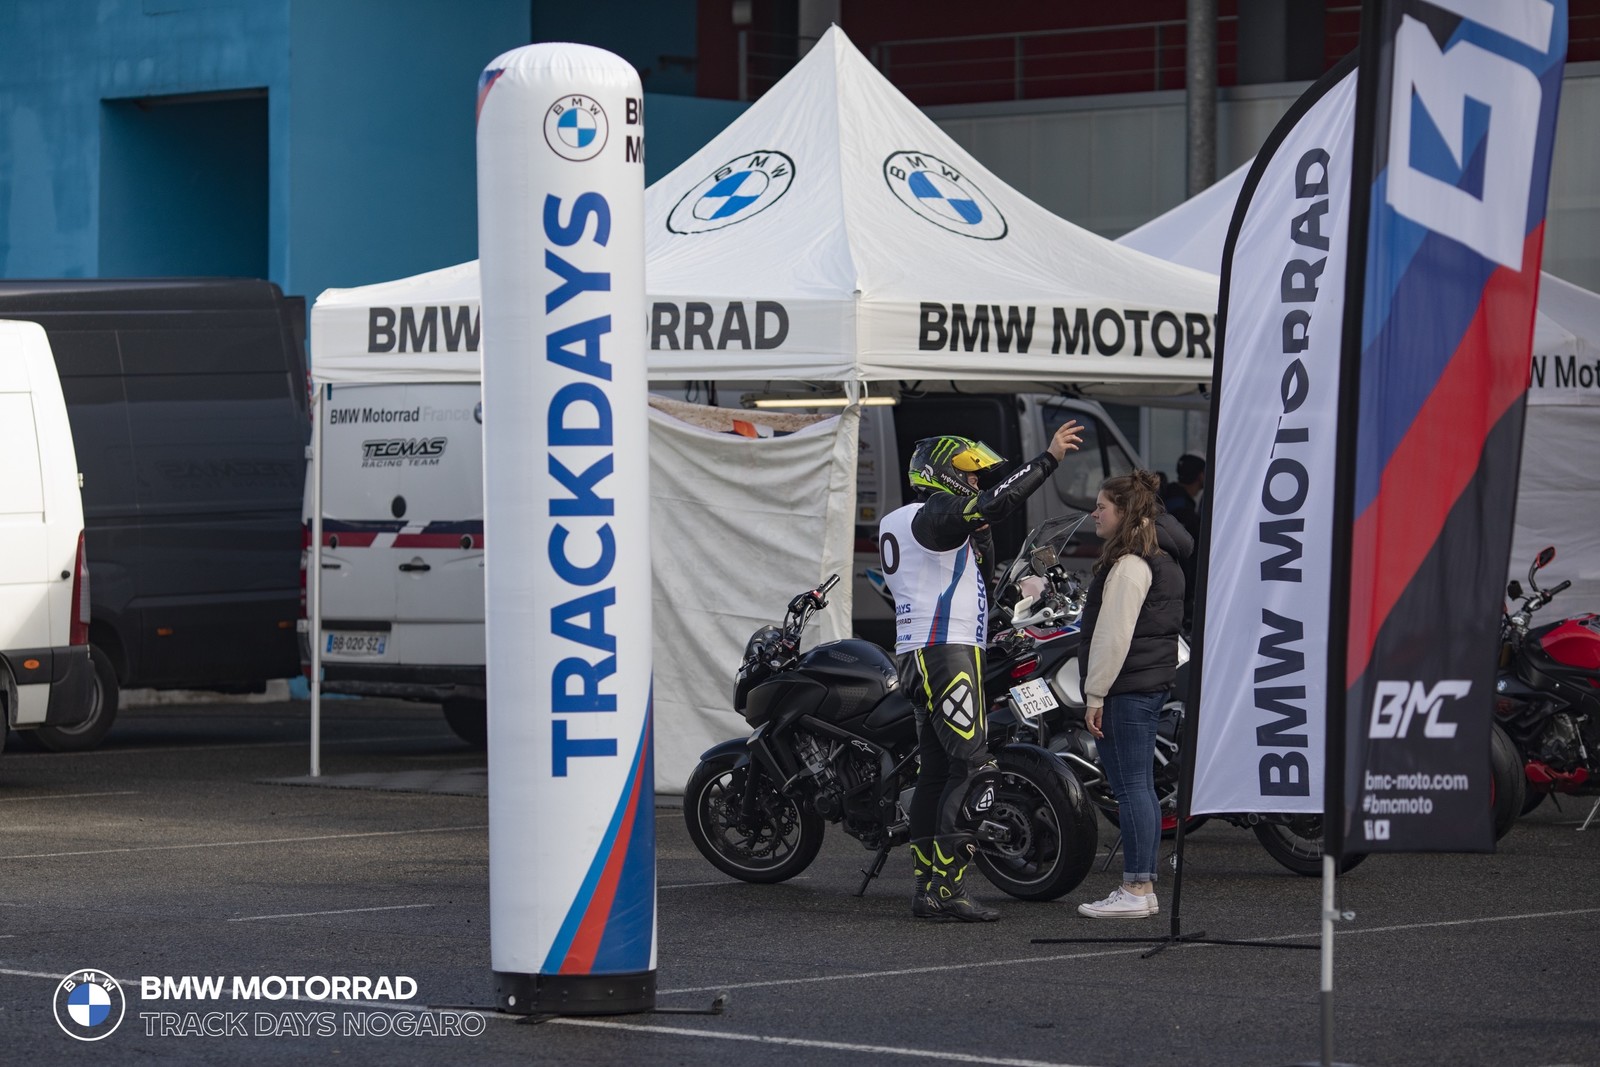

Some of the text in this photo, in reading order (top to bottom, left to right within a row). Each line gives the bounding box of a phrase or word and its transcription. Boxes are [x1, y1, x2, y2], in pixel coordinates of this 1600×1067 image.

[552, 98, 600, 116] BMW
[714, 156, 789, 182] BMW
[890, 156, 960, 181] BMW
[367, 301, 790, 353] BMW RRAD
[919, 302, 1217, 359] BMW MOTOR
[330, 407, 470, 425] BMW Motorrad France
[363, 440, 445, 458] TECMAS
[361, 458, 440, 468] RACING TEAM
[1254, 147, 1331, 797] BMW MOTORRAD
[543, 191, 617, 778] TRACKDAYS
[994, 463, 1031, 498] IXON
[880, 532, 900, 576] 0
[1369, 680, 1473, 739] BMC
[1365, 770, 1469, 790] bmc-moto.com
[1362, 794, 1433, 814] #bmcmoto
